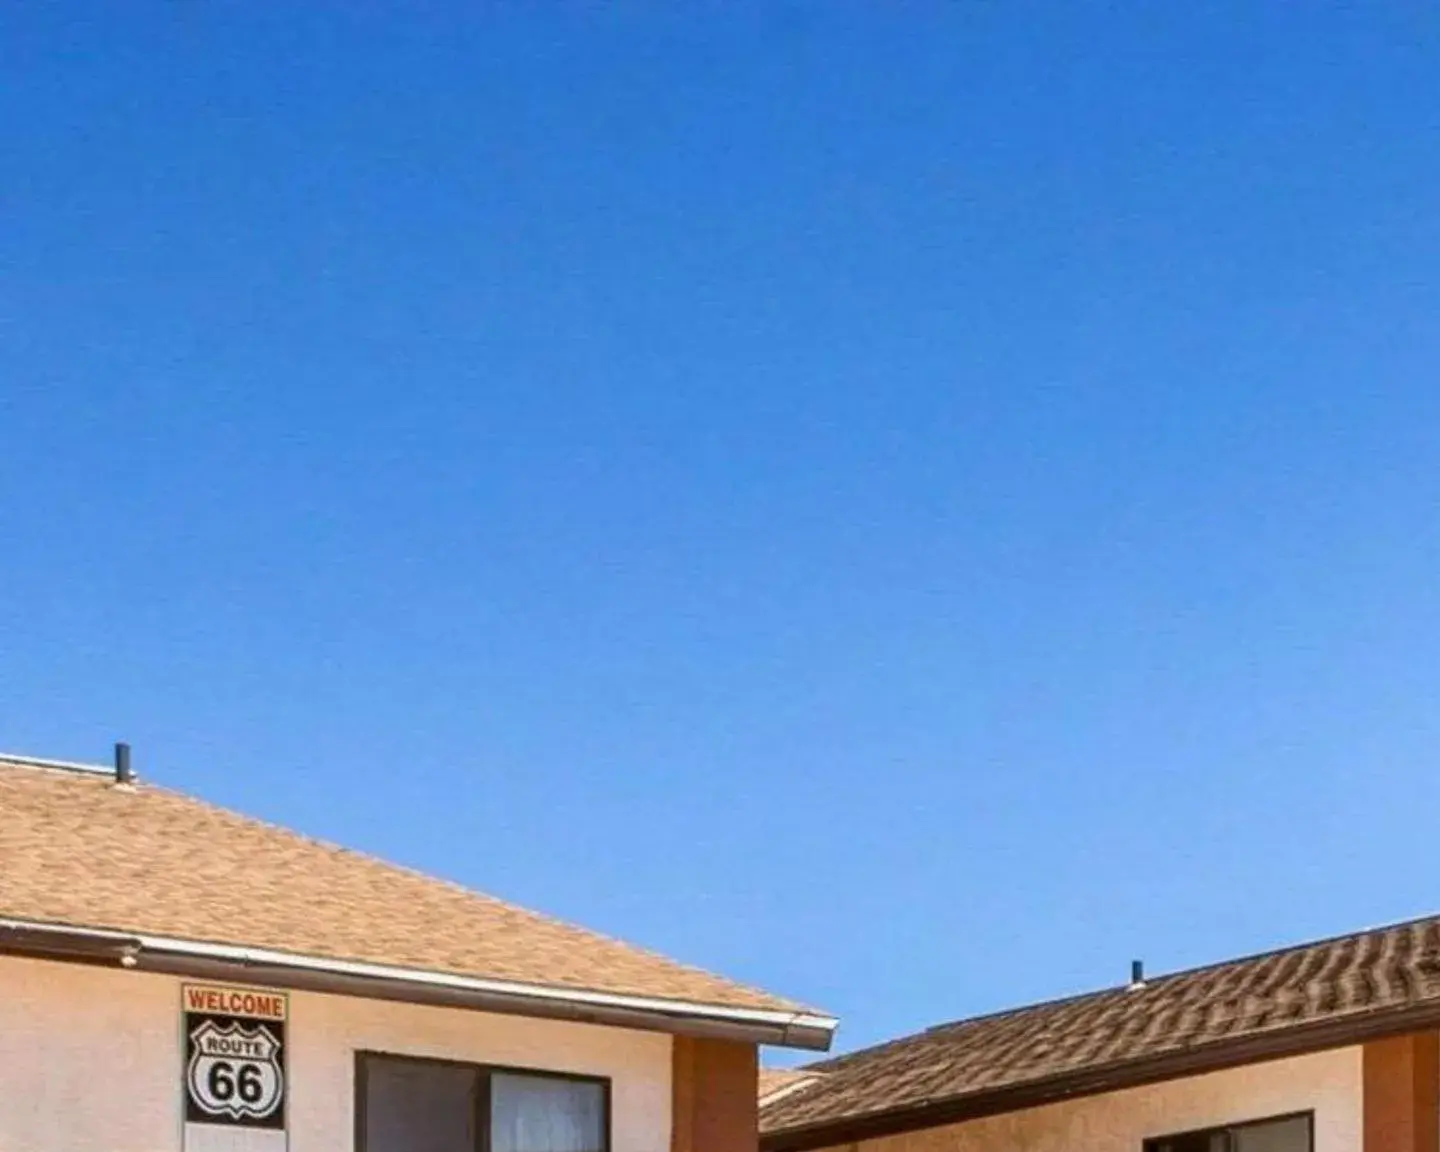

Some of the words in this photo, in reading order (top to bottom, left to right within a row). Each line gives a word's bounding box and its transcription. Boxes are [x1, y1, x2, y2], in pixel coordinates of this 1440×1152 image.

[189, 990, 283, 1016] WELCOME
[207, 1037, 264, 1055] ROUTE
[209, 1061, 262, 1103] 66
